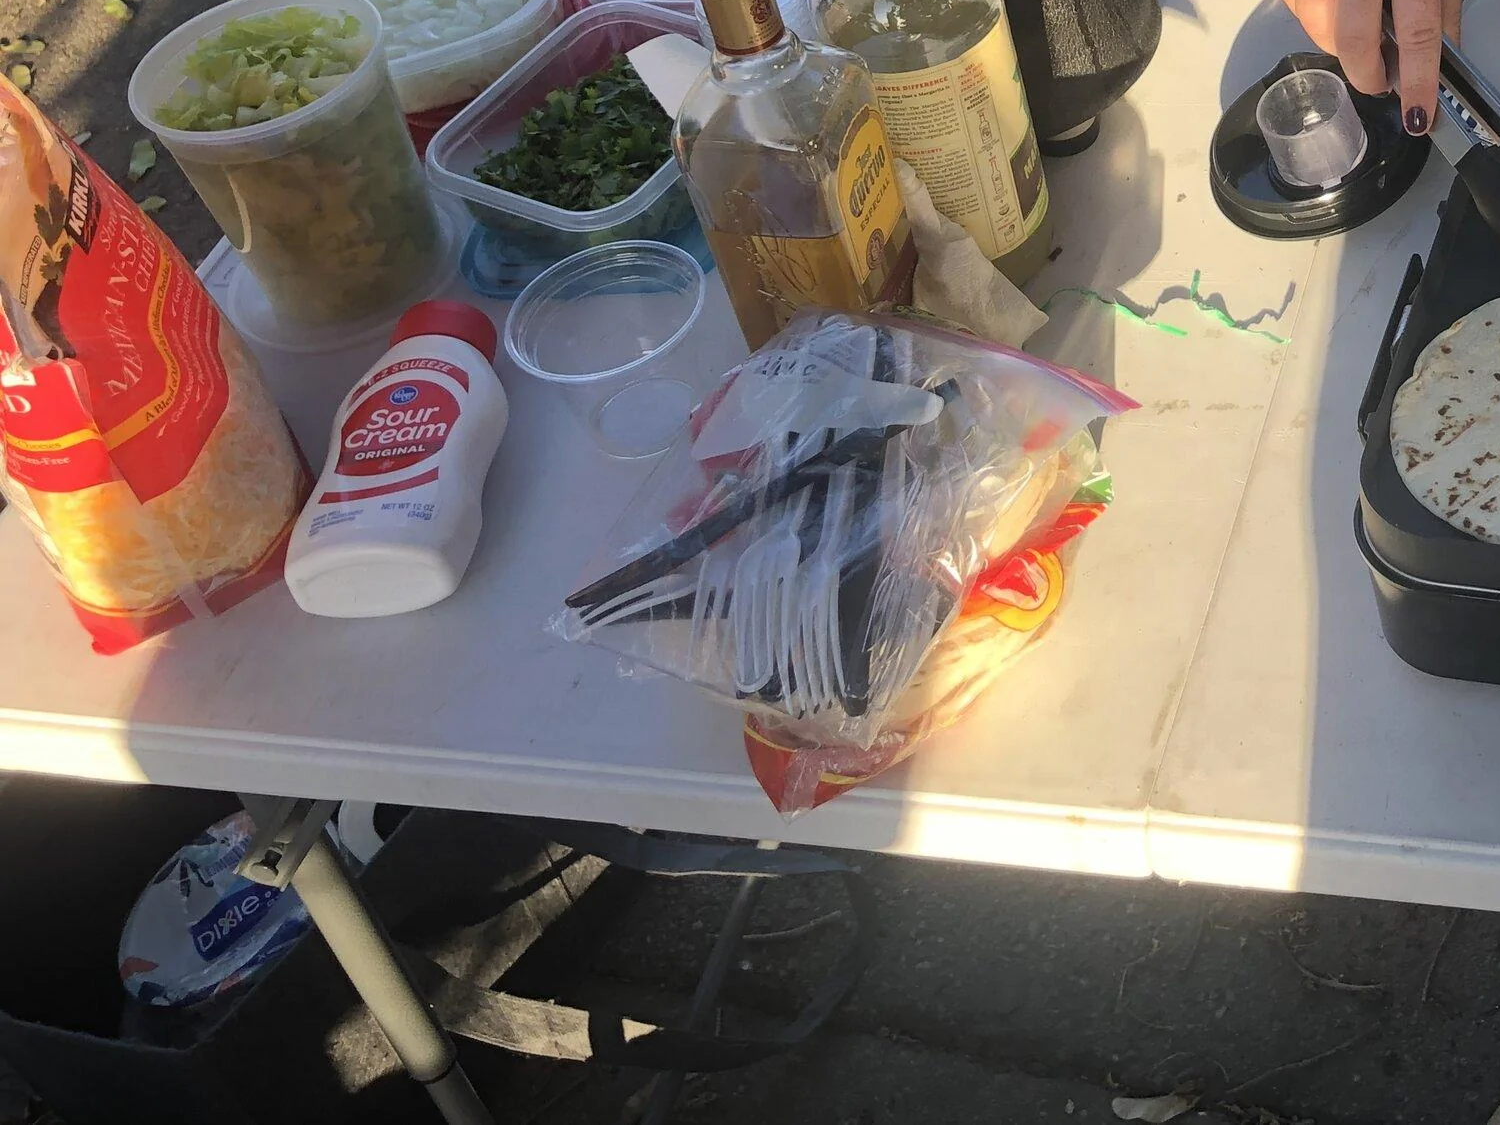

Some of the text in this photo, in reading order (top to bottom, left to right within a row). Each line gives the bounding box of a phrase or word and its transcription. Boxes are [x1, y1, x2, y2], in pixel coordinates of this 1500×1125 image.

[902, 76, 949, 91] DIFFERENCE
[860, 178, 889, 232] ESPECIAL
[391, 359, 453, 373] SQUEEZE
[366, 406, 440, 430] Sour
[344, 422, 447, 449] Cream
[354, 444, 426, 461] ORIGINAL
[381, 503, 396, 511] NET
[398, 502, 410, 510] WT
